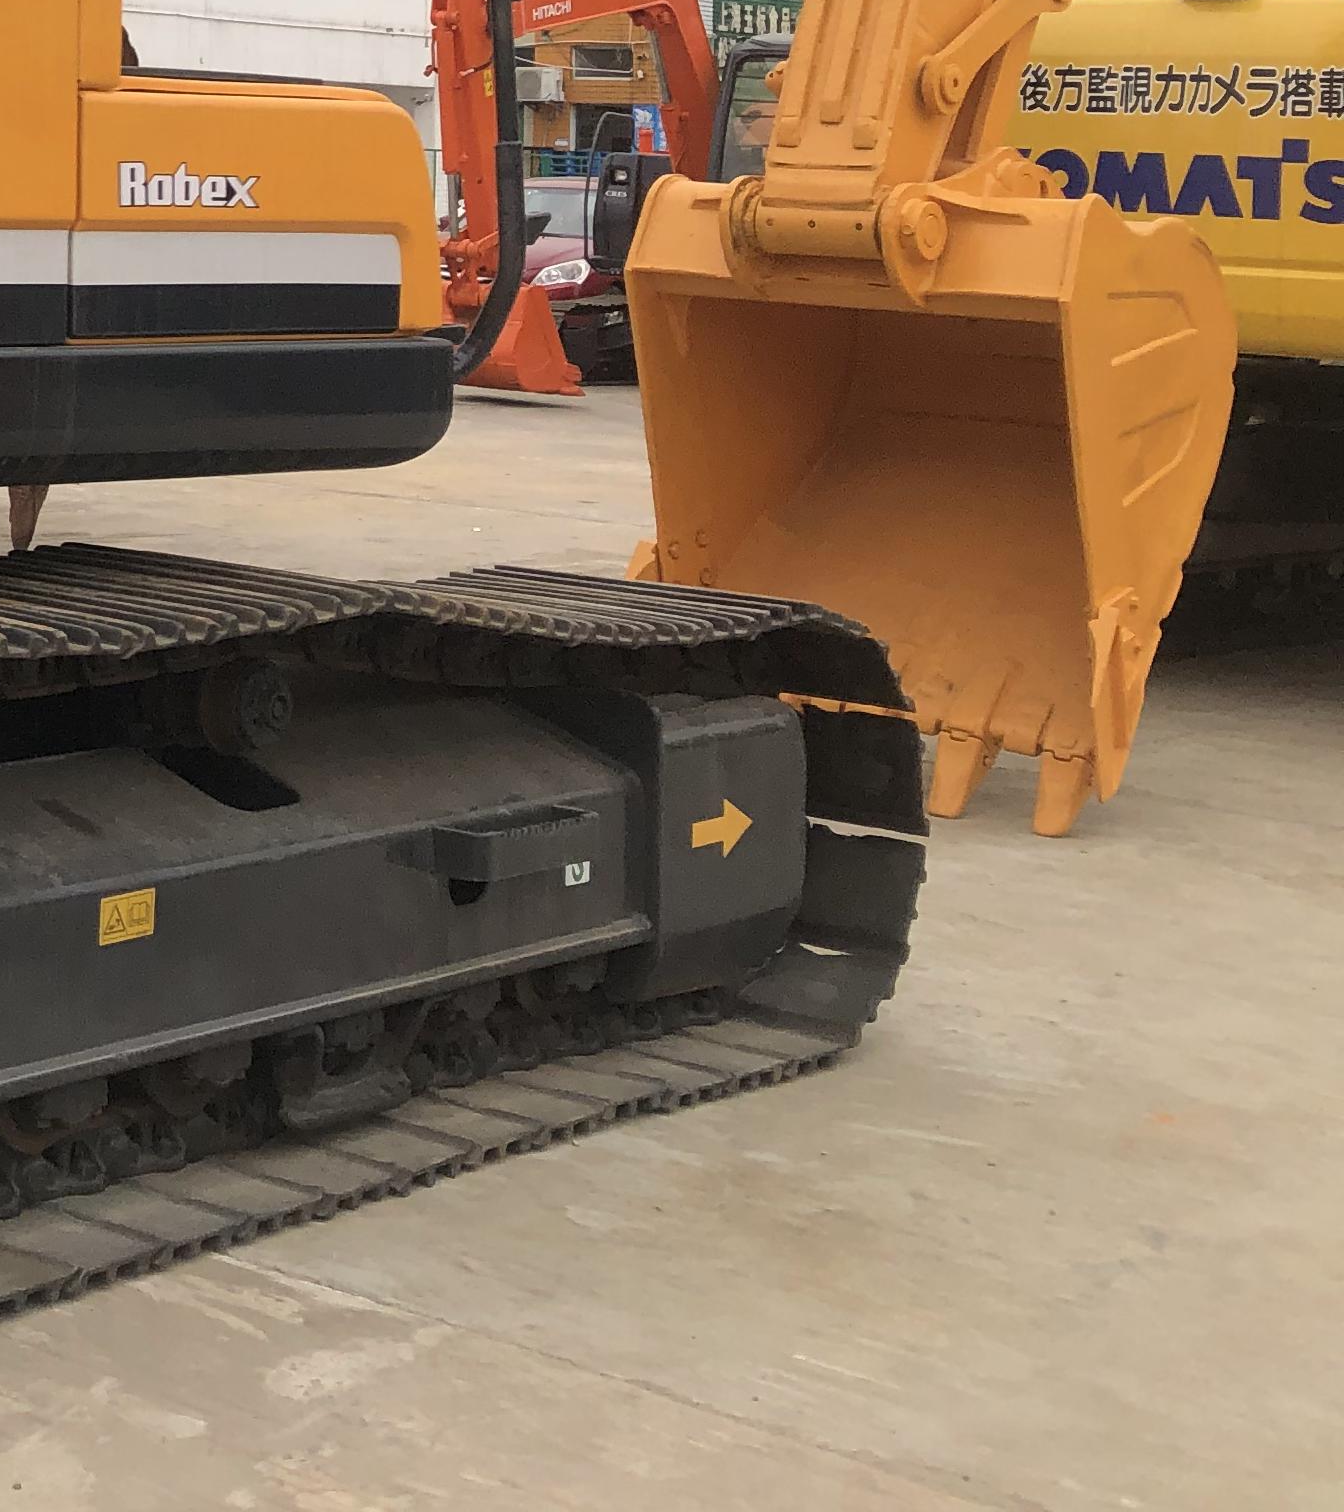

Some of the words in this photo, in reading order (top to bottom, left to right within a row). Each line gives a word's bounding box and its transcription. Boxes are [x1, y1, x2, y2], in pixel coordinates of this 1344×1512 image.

[532, 0, 572, 21] HITACHI
[118, 161, 261, 208] Robex
[1016, 139, 1344, 225] OMATS
